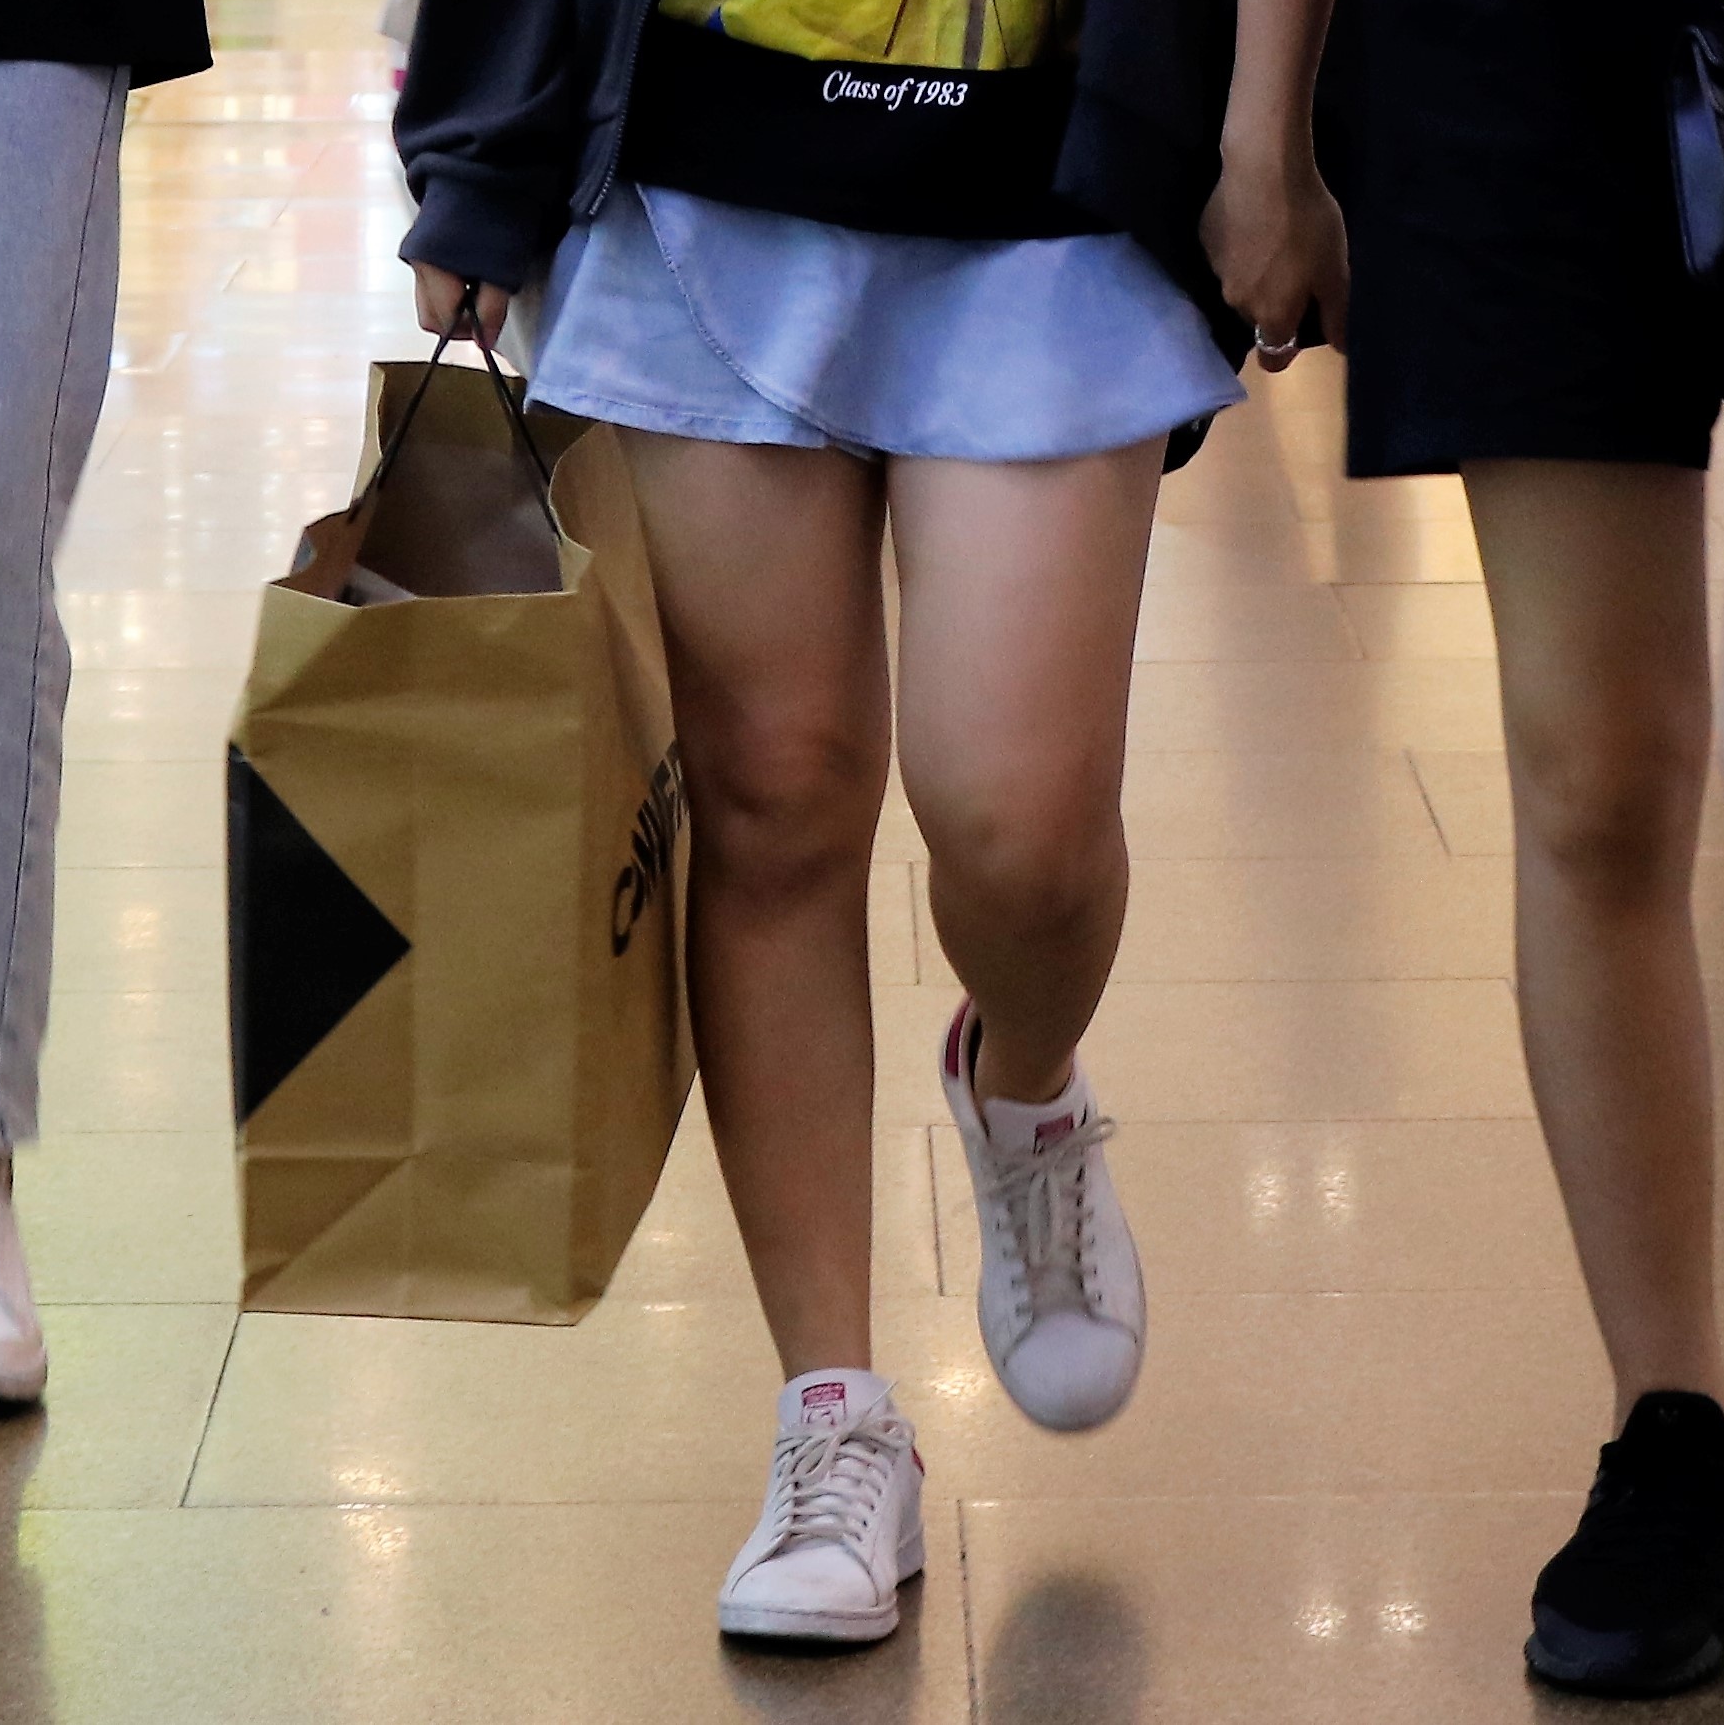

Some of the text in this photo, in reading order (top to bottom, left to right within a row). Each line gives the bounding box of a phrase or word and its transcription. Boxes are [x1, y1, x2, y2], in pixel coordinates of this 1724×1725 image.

[822, 70, 968, 111] Class of 1983
